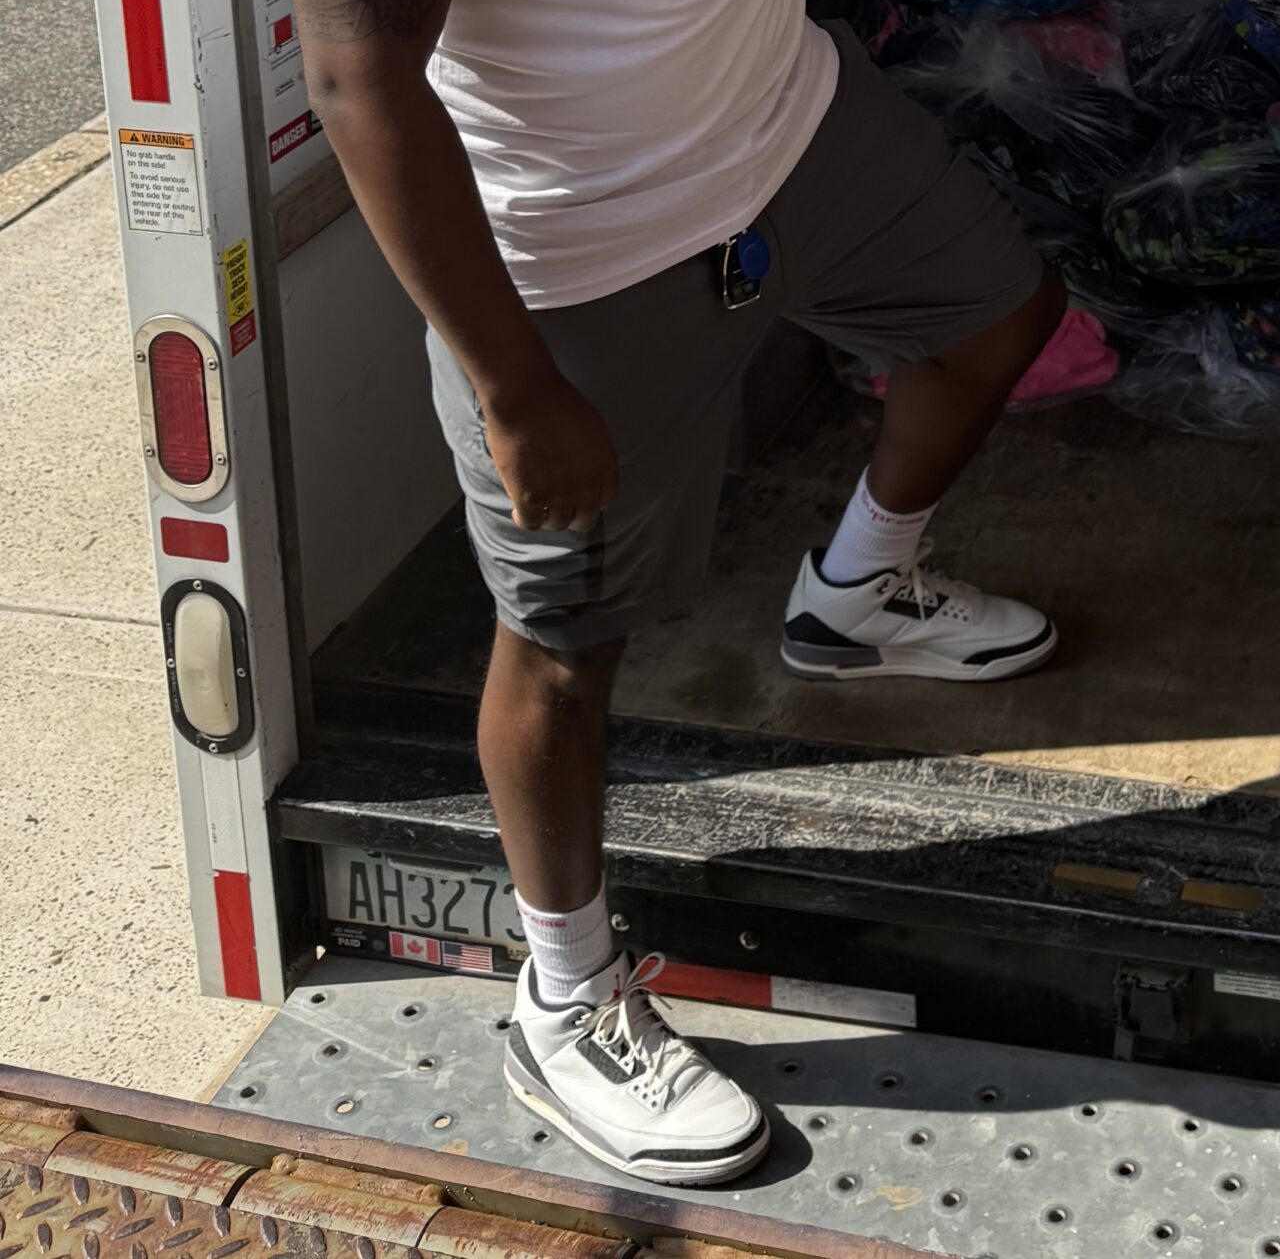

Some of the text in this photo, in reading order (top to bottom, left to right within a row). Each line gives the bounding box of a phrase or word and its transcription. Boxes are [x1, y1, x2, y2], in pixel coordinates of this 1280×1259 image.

[142, 133, 185, 146] WARNING
[272, 121, 307, 157] DANGER
[127, 150, 176, 161] No grab handle
[130, 171, 138, 179] To
[140, 173, 158, 181] avoid
[153, 183, 161, 191] do
[131, 190, 144, 198] this
[133, 200, 161, 209] entering
[172, 204, 195, 212] exiting
[133, 208, 145, 216] the
[338, 937, 361, 948] PAID
